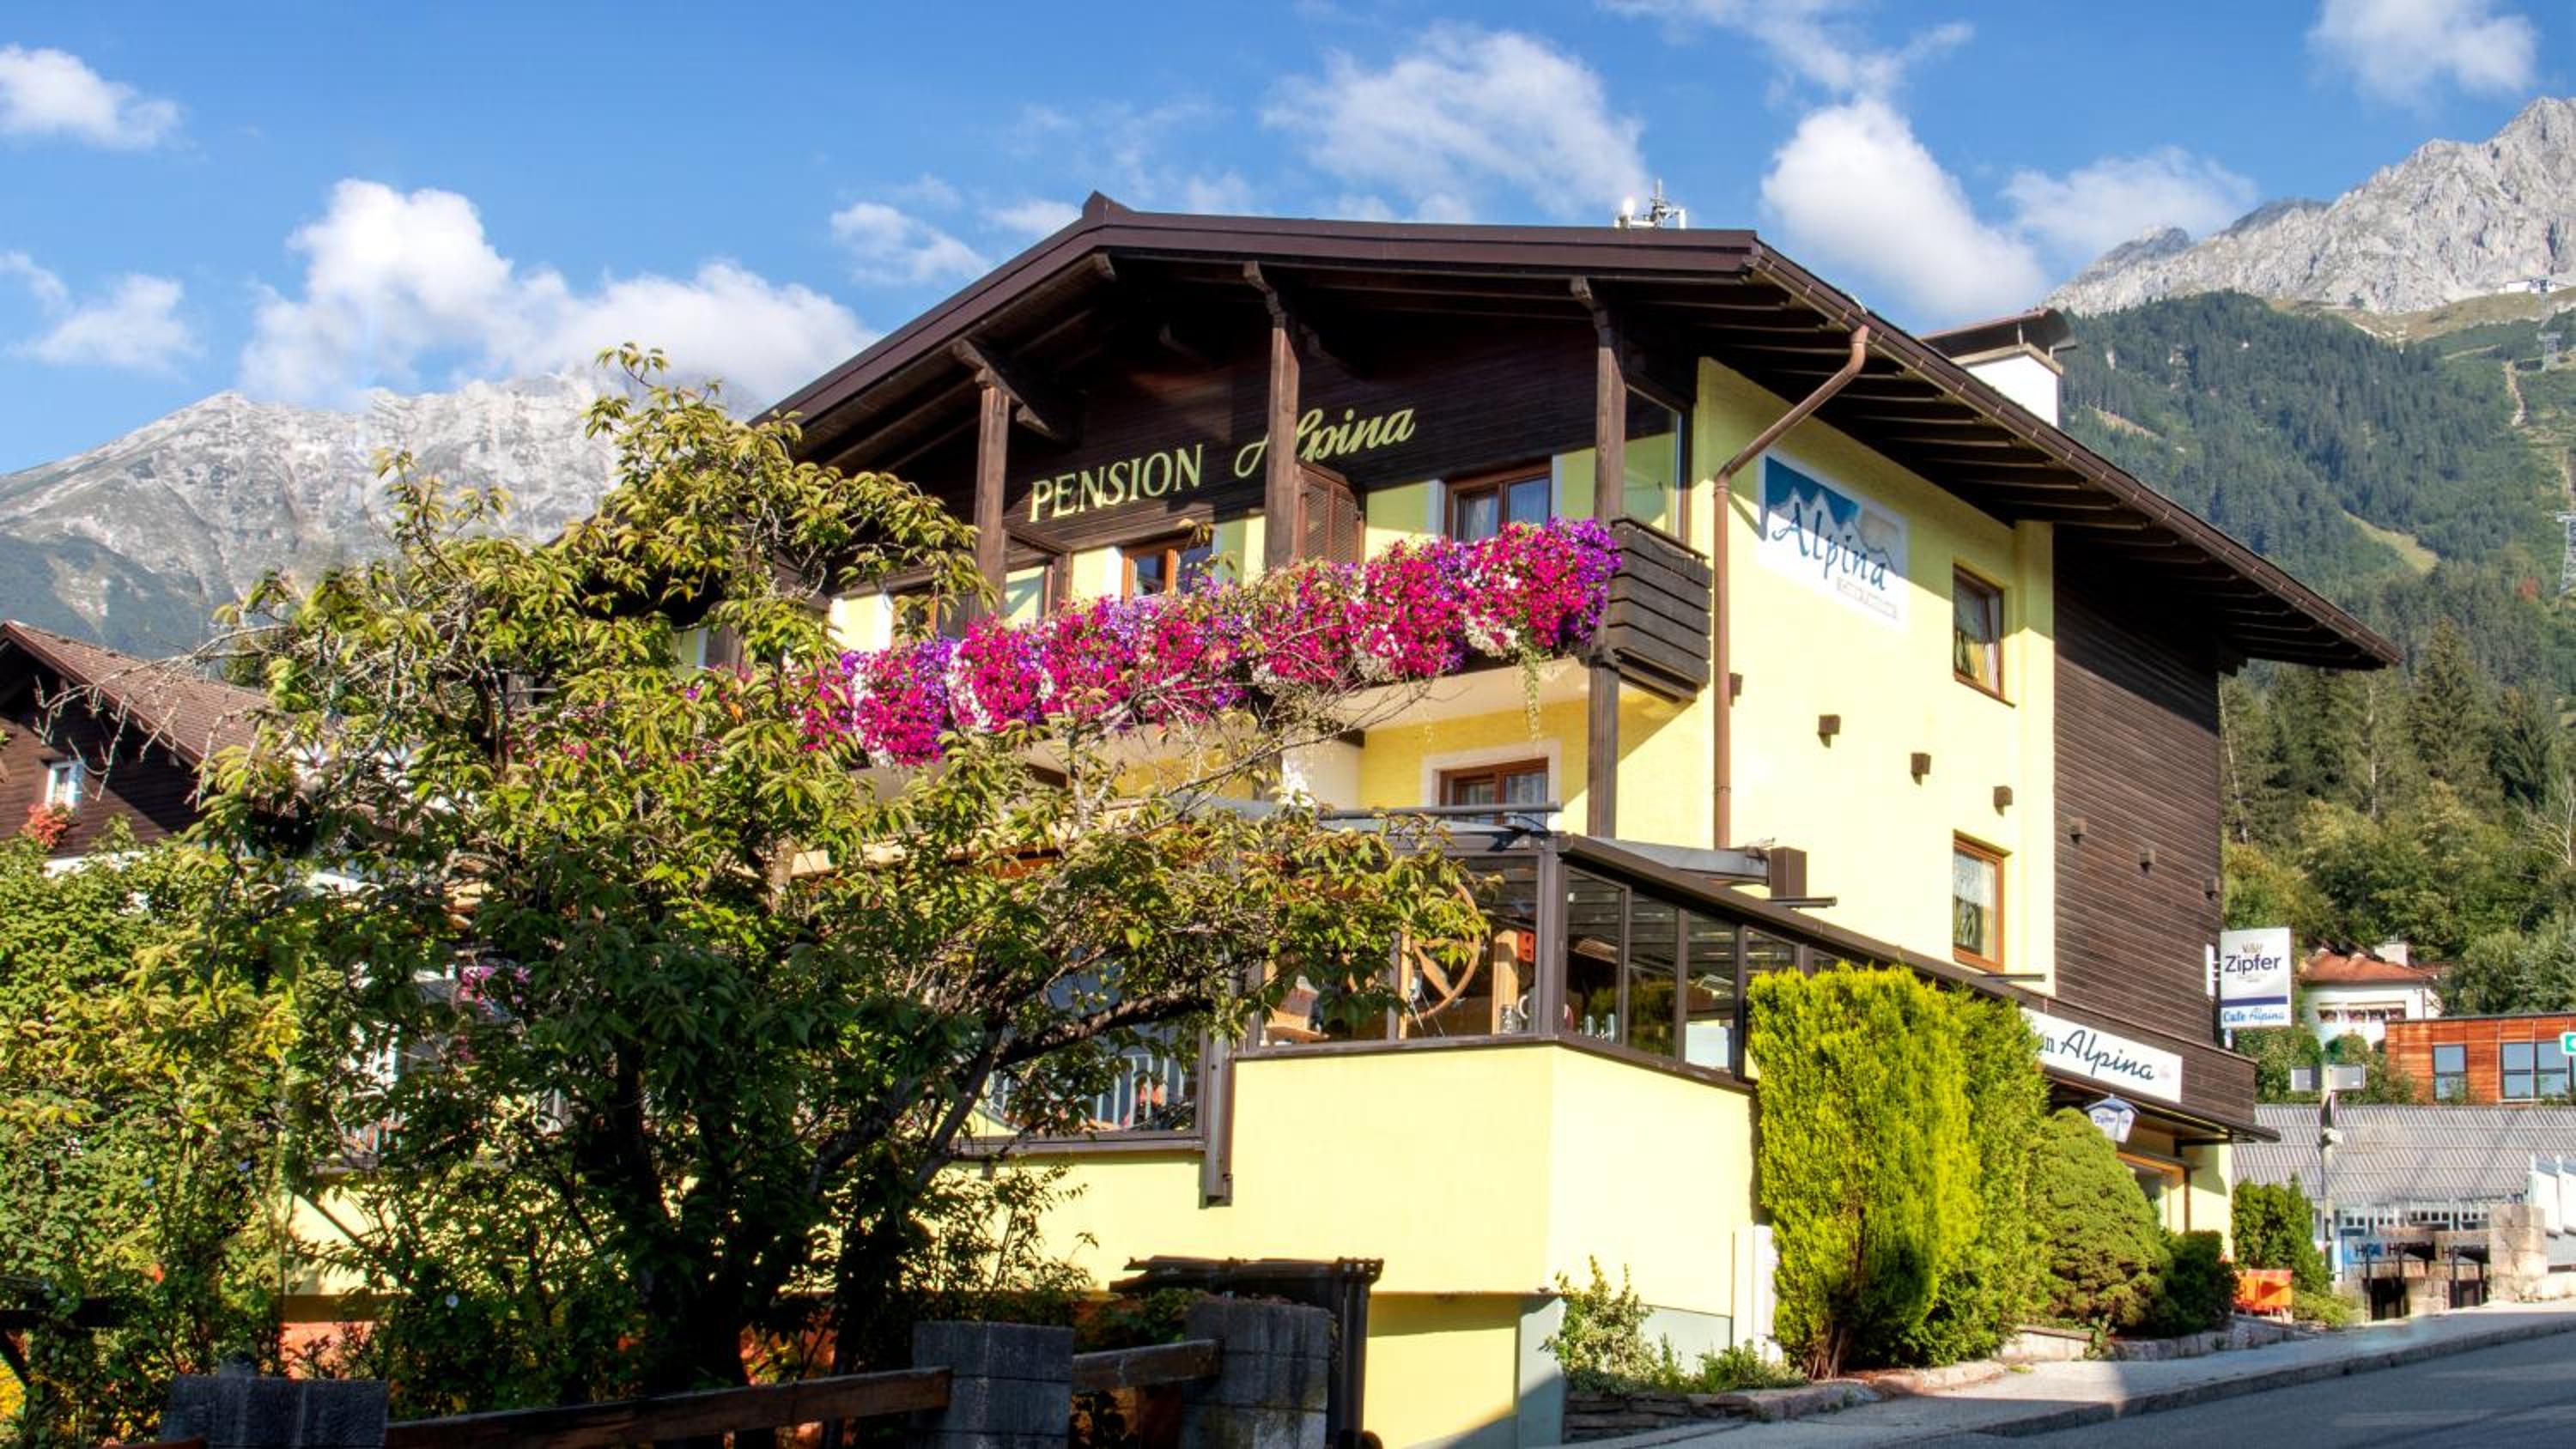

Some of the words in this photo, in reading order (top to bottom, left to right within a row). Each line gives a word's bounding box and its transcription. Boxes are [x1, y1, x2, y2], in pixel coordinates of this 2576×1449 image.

[1030, 443, 1204, 523] PENSION
[1771, 501, 1886, 591] Alpina
[2225, 954, 2281, 975] Zipfer
[2061, 1029, 2154, 1081] Alpina
